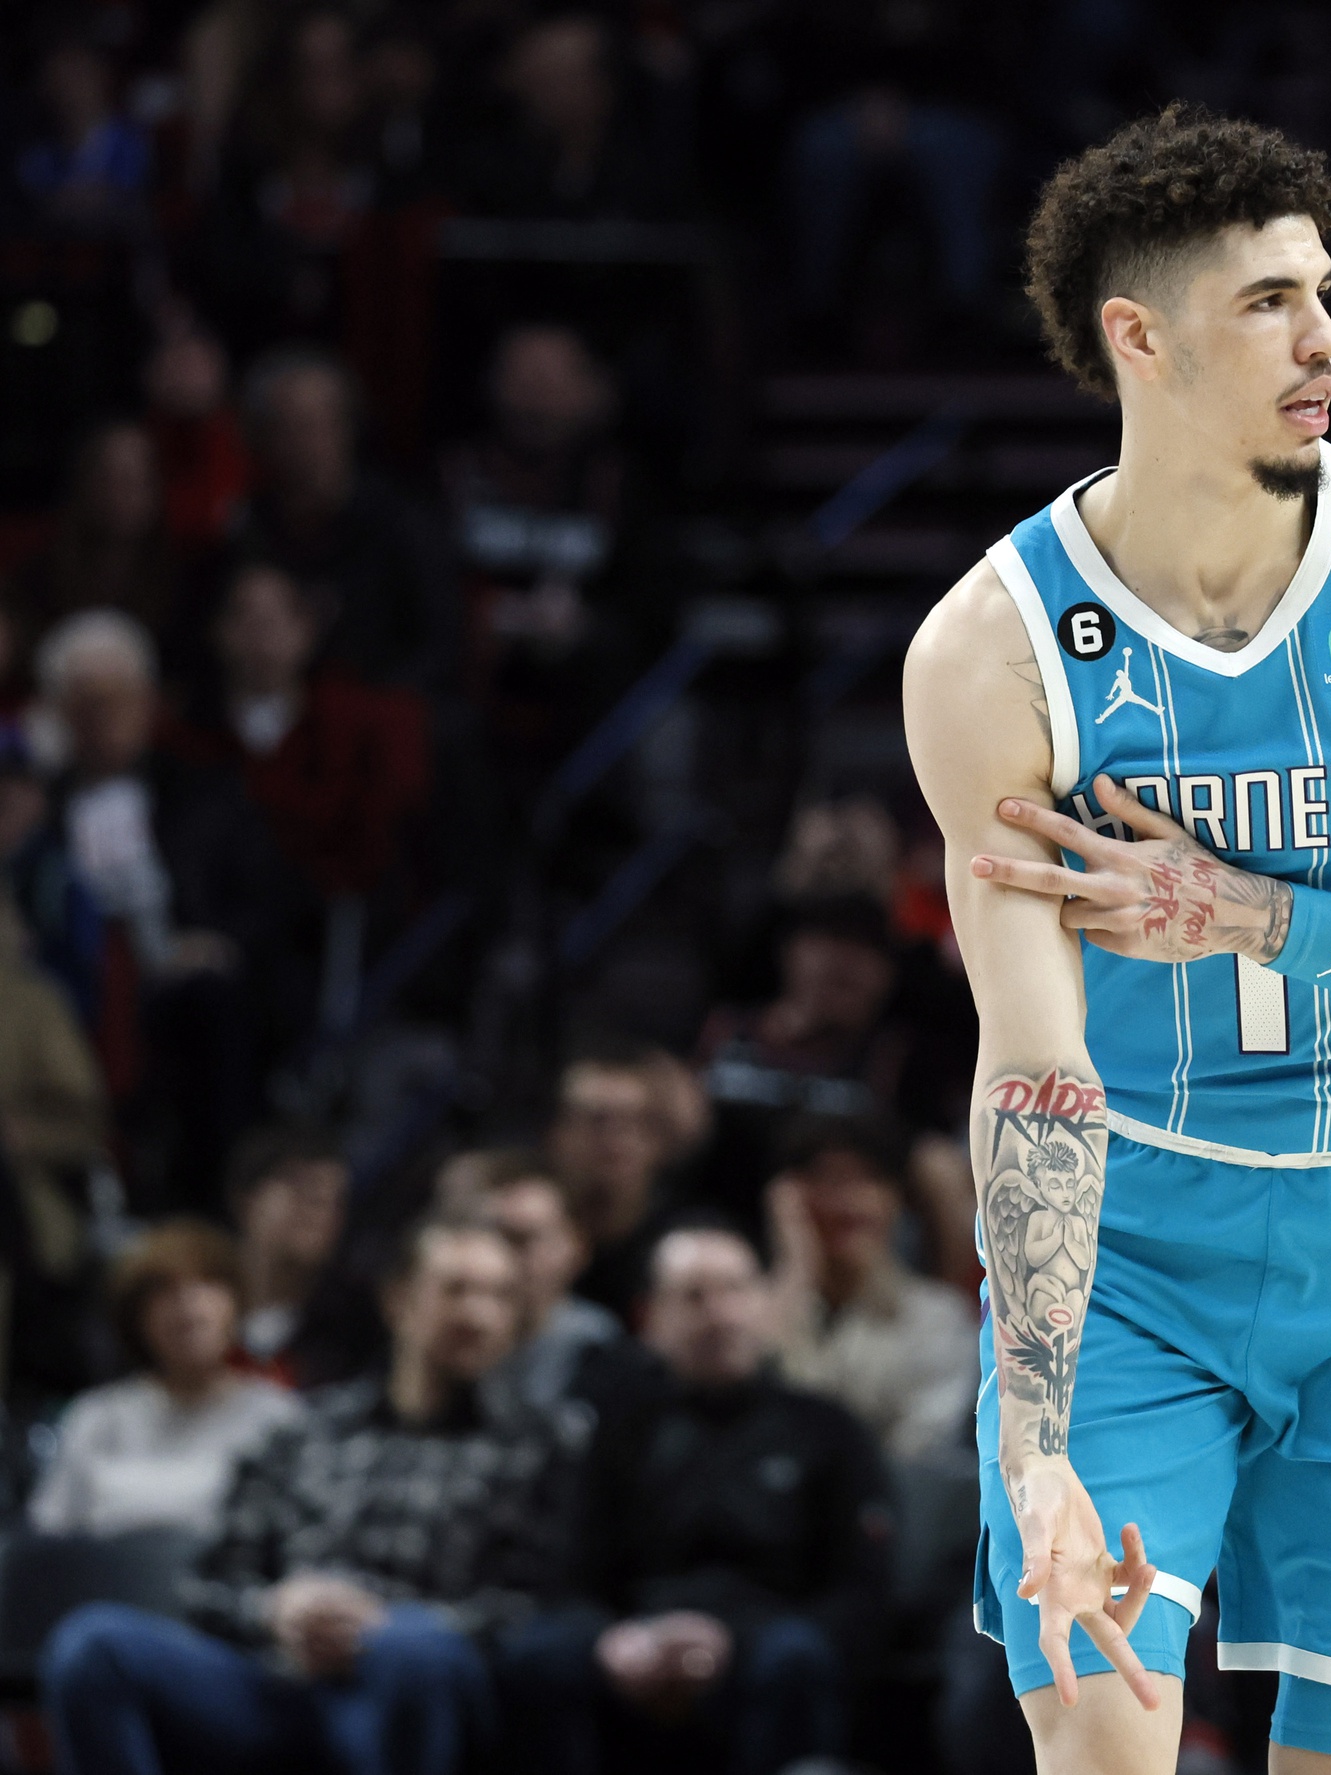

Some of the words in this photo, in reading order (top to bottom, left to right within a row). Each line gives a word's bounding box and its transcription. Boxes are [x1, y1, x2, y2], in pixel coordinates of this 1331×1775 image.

[1070, 610, 1104, 654] 6
[1190, 857, 1220, 898] NOT
[1137, 862, 1183, 940] HERE
[1180, 898, 1215, 947] FROM
